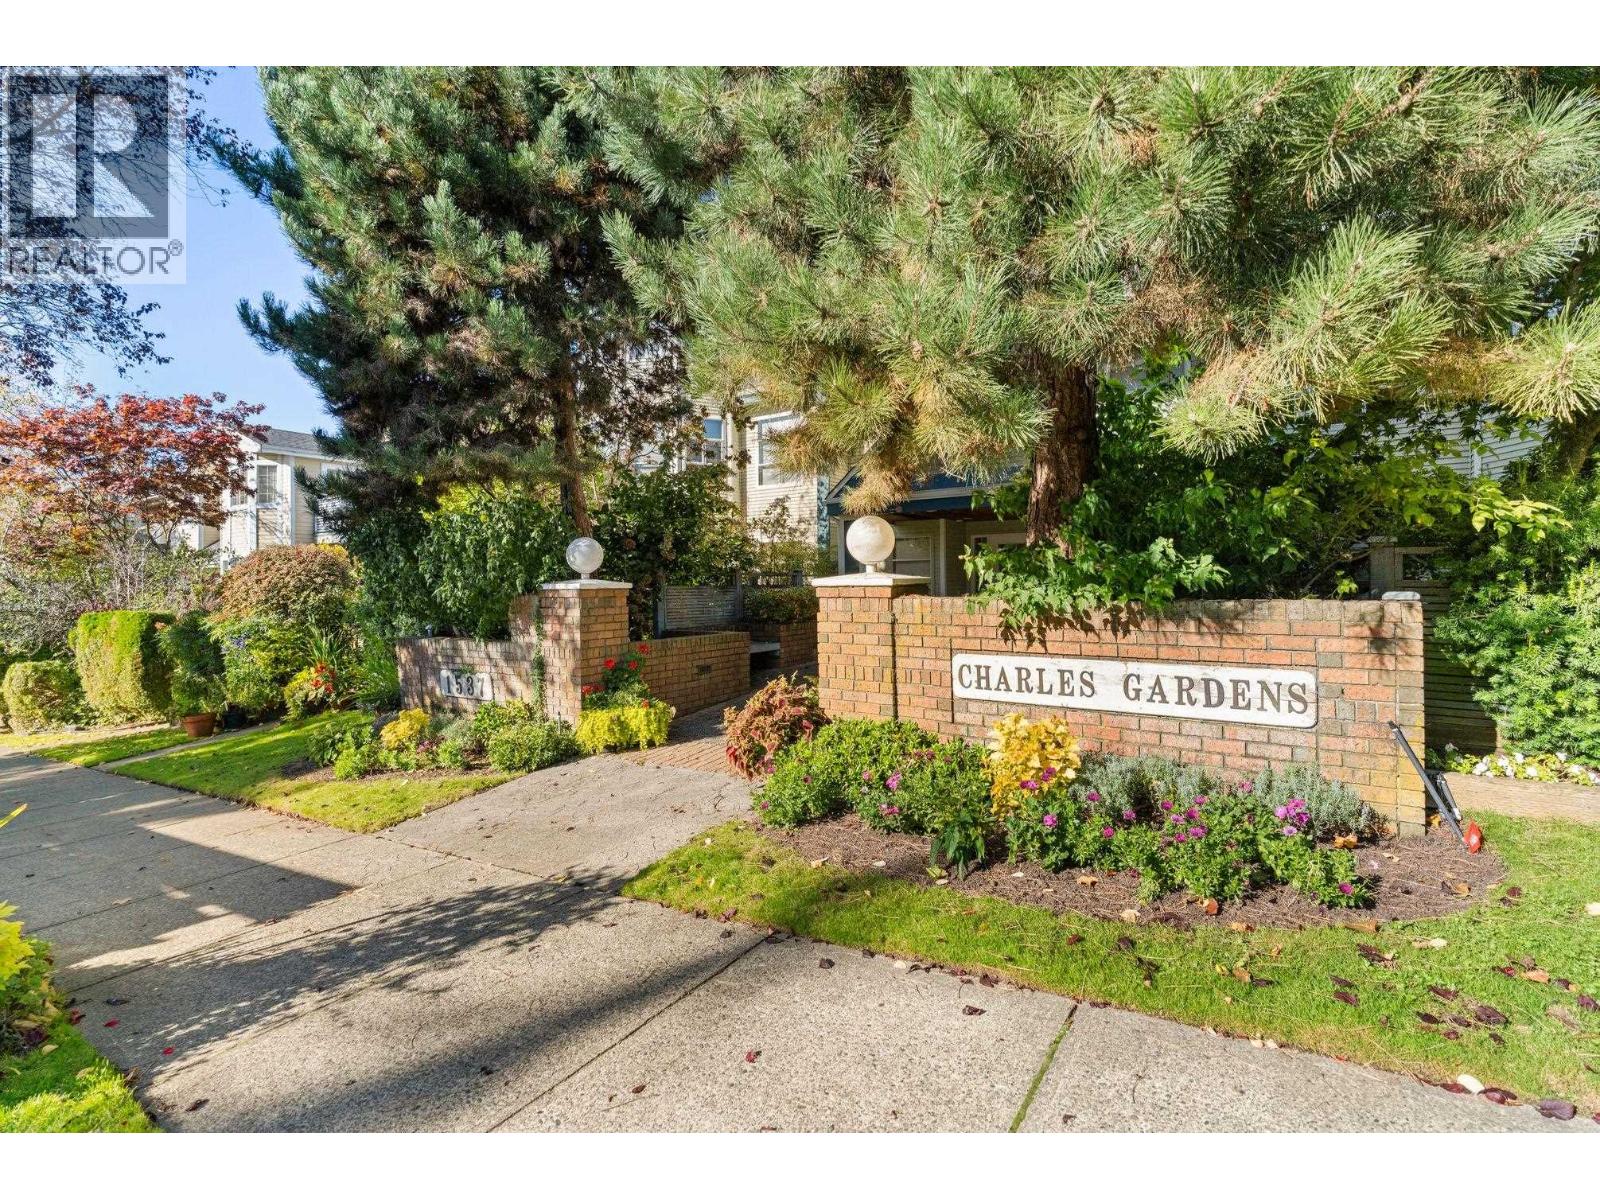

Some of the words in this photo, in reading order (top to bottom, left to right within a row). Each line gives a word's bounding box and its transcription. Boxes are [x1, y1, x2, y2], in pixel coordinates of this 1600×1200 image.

[446, 674, 485, 697] 1537
[957, 663, 1096, 698] CHARLES
[1122, 673, 1309, 715] GARDENS
